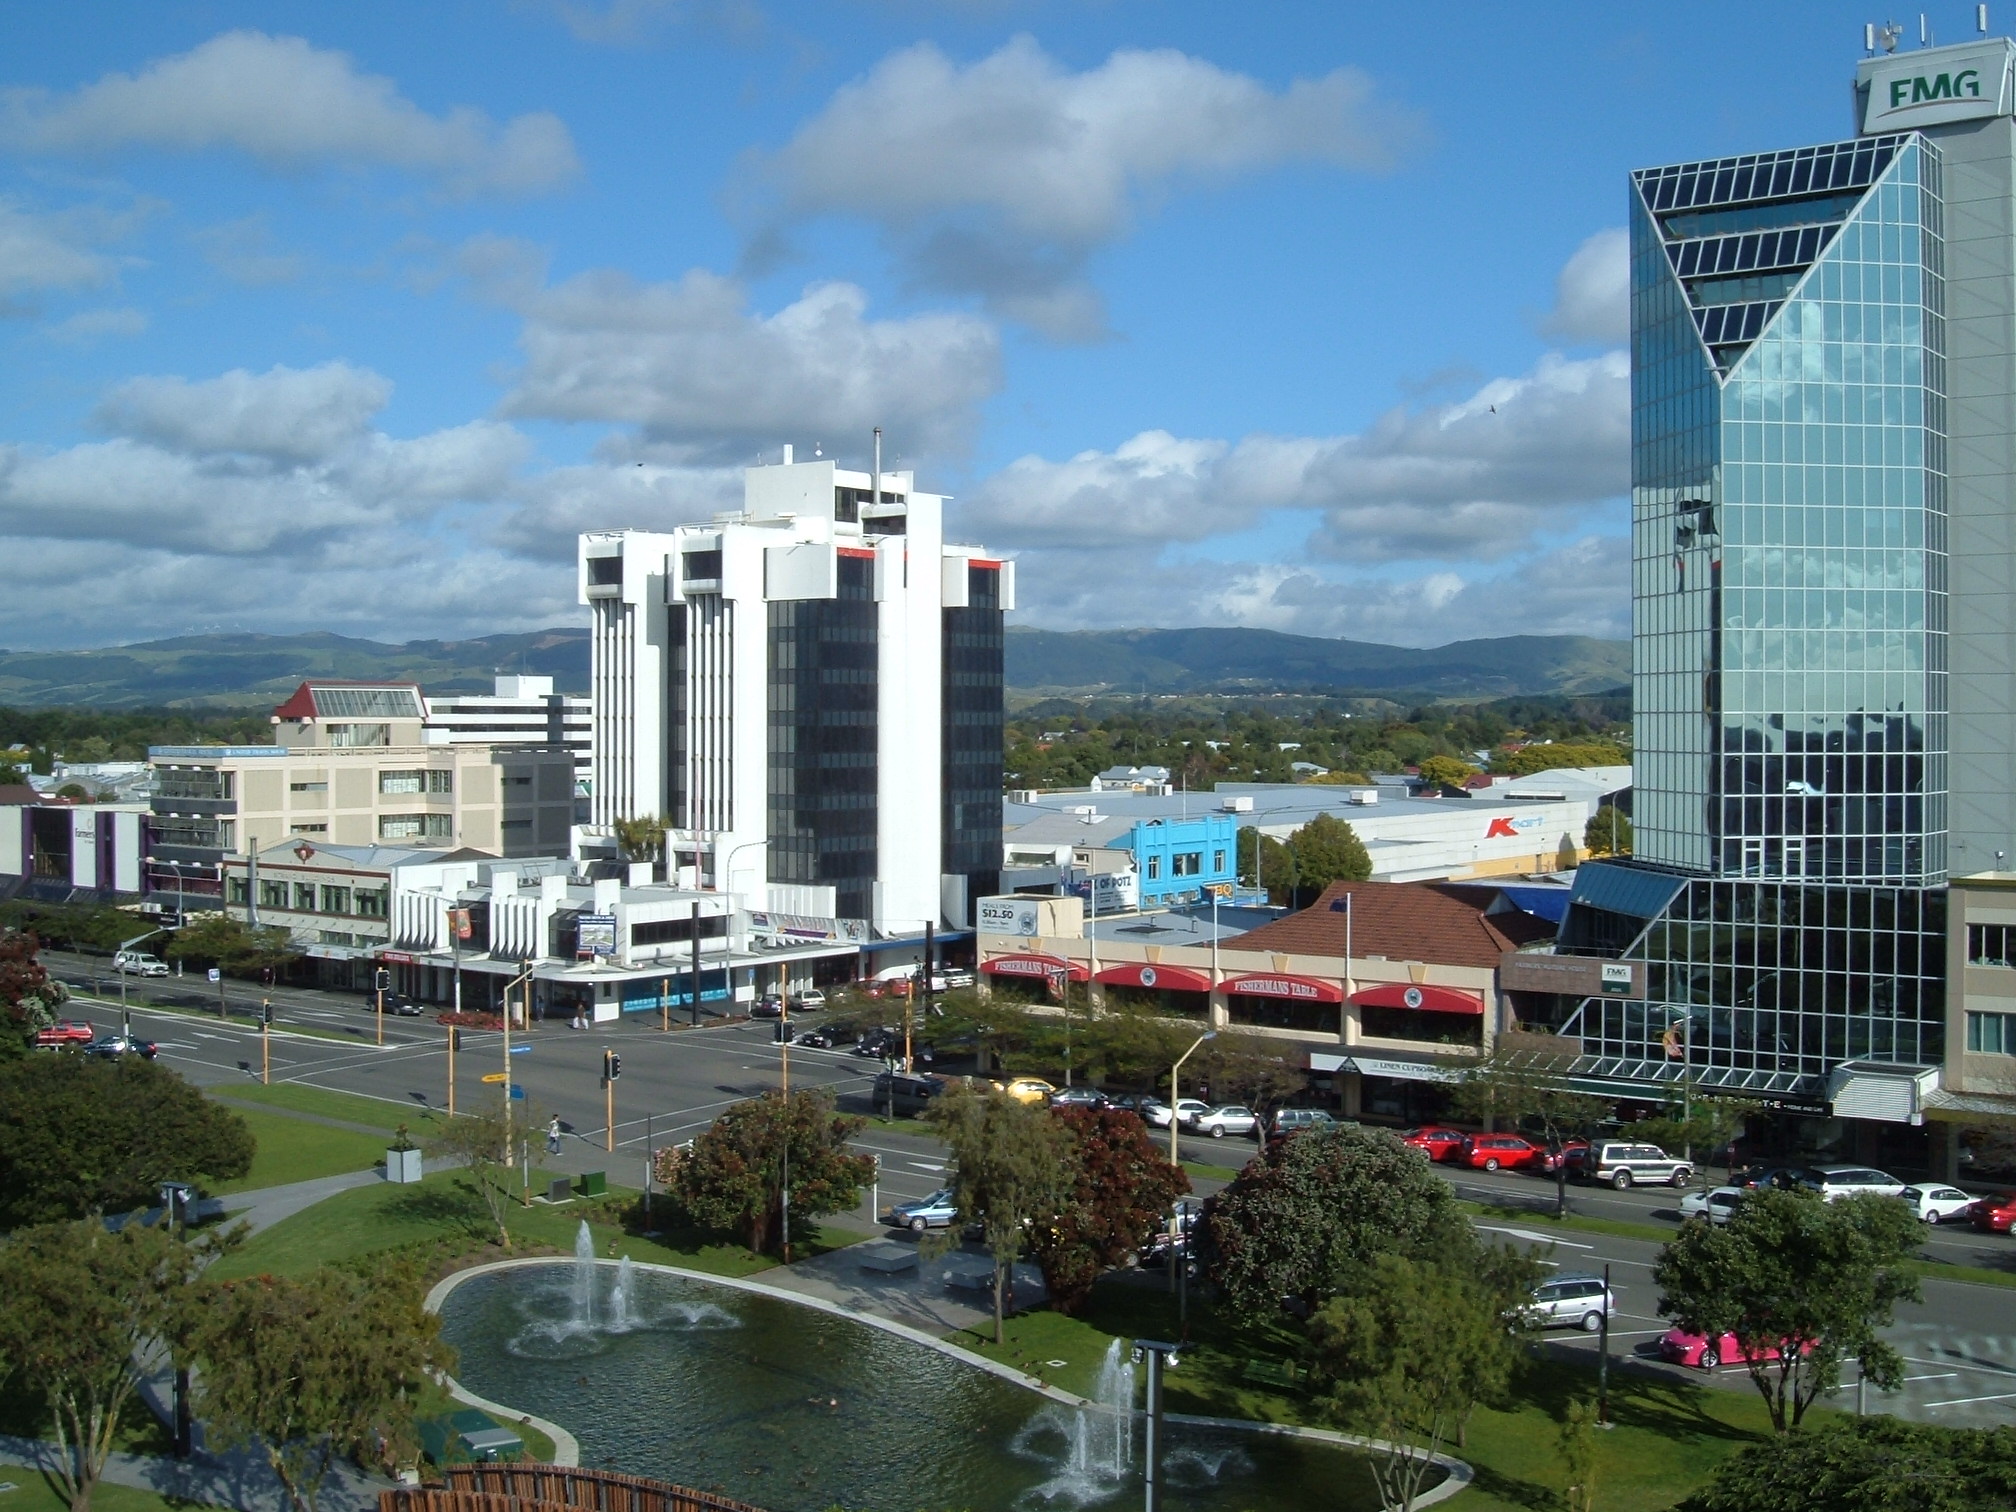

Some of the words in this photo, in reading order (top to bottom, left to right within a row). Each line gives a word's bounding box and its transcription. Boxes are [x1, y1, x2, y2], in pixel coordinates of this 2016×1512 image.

[1890, 70, 1979, 108] FMG
[1100, 878, 1111, 889] OF
[1112, 876, 1132, 888] POTZ
[982, 909, 1014, 919] $12.50
[994, 960, 1043, 975] FISHERMANS
[1606, 967, 1627, 976] FMG
[1234, 980, 1289, 995] FISHERMANS
[1290, 983, 1318, 998] TABLE
[1379, 1062, 1401, 1071] LINEN
